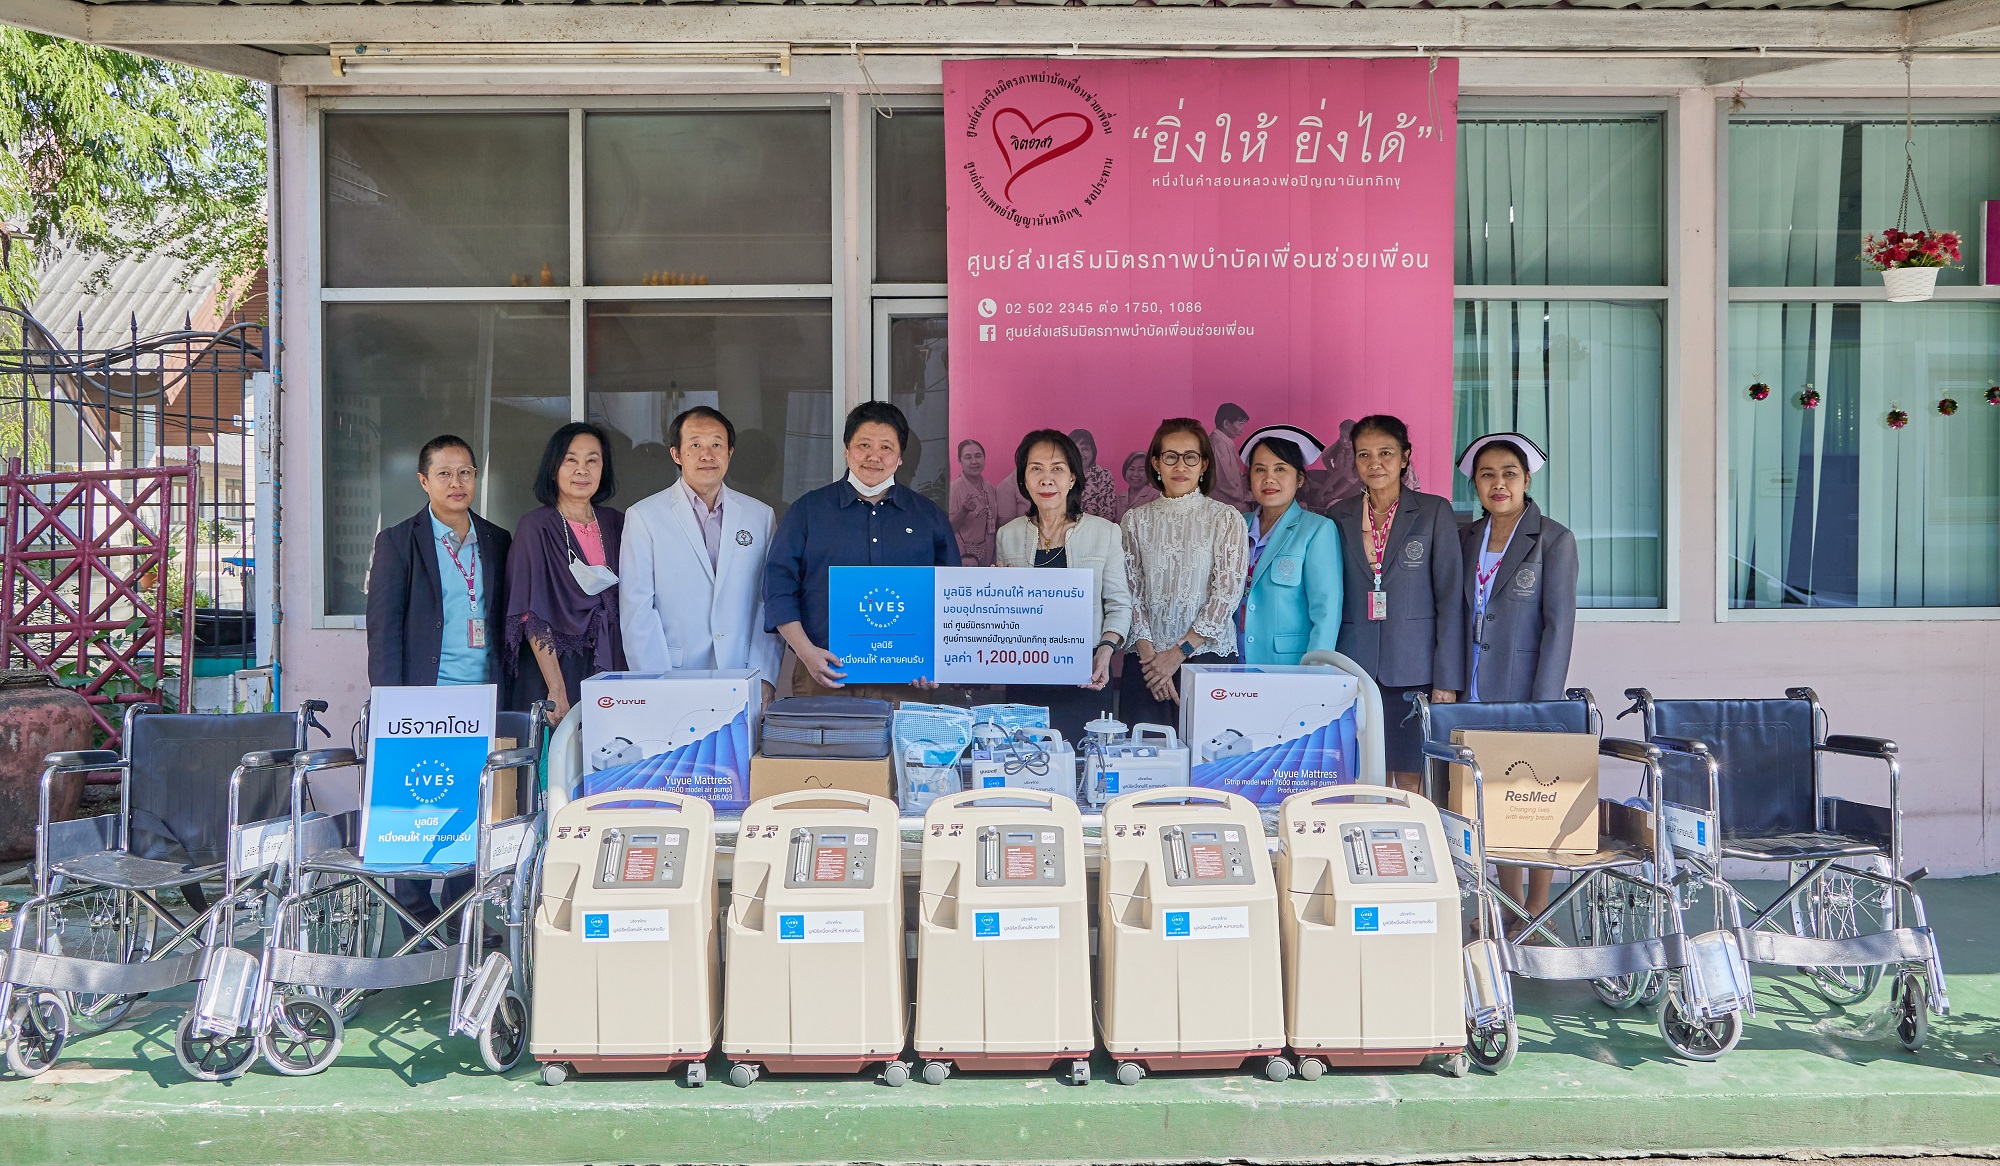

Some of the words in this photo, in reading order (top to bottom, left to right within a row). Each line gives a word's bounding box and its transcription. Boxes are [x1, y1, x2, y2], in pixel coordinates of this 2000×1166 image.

[1010, 135, 1053, 150] จิตอาสา
[1084, 157, 1114, 206] ชลประทาน
[967, 242, 1430, 277] ศูนย์ส่งเสริมมิตรภาพบำบัดเพื่อนช่วยเพื่อน
[1005, 302, 1022, 314] 02
[1027, 302, 1053, 313] 502
[1059, 302, 1093, 313] 2345
[1099, 300, 1119, 313] ต่อ
[1125, 302, 1163, 314] 1750,
[1169, 301, 1202, 313] 1086
[1005, 320, 1255, 341] ศูนย์ส่งเสริมมิตรภาพบำบัดเพื่อนช่วยเพื่อน
[943, 586, 973, 600] มูลนิธิ
[976, 582, 1024, 598] หนึ่งคนให้
[1027, 586, 1085, 599] หลายคนรับ
[943, 604, 1044, 616] มอบอุปกรณ์การแพทย์
[955, 620, 1020, 631] ศูนย์มิตรภาพบำบัด
[871, 641, 893, 651] มูลนิธิ
[1049, 635, 1085, 644] ชลประทาน
[839, 653, 878, 664] หนึ่งคนให้
[880, 654, 924, 664] หลายคนรับ
[944, 651, 972, 666] มูลค่า
[976, 649, 1050, 665] 1,200,000
[1053, 655, 1074, 664] บาท
[388, 716, 480, 735] บริจาคโดย
[1273, 768, 1299, 781] Yuyue
[1301, 769, 1338, 779] Mattress
[665, 776, 692, 787] Yuyue
[694, 776, 732, 785] Mattress
[1224, 778, 1240, 786] (Strip
[714, 785, 733, 793] pump)
[410, 788, 449, 804] FOUNDATION
[1505, 790, 1558, 803] ResMed
[414, 817, 439, 829] มูลนิธิ
[378, 830, 421, 843] หนึ่งคนให้
[423, 832, 471, 842] หลายคนรับ
